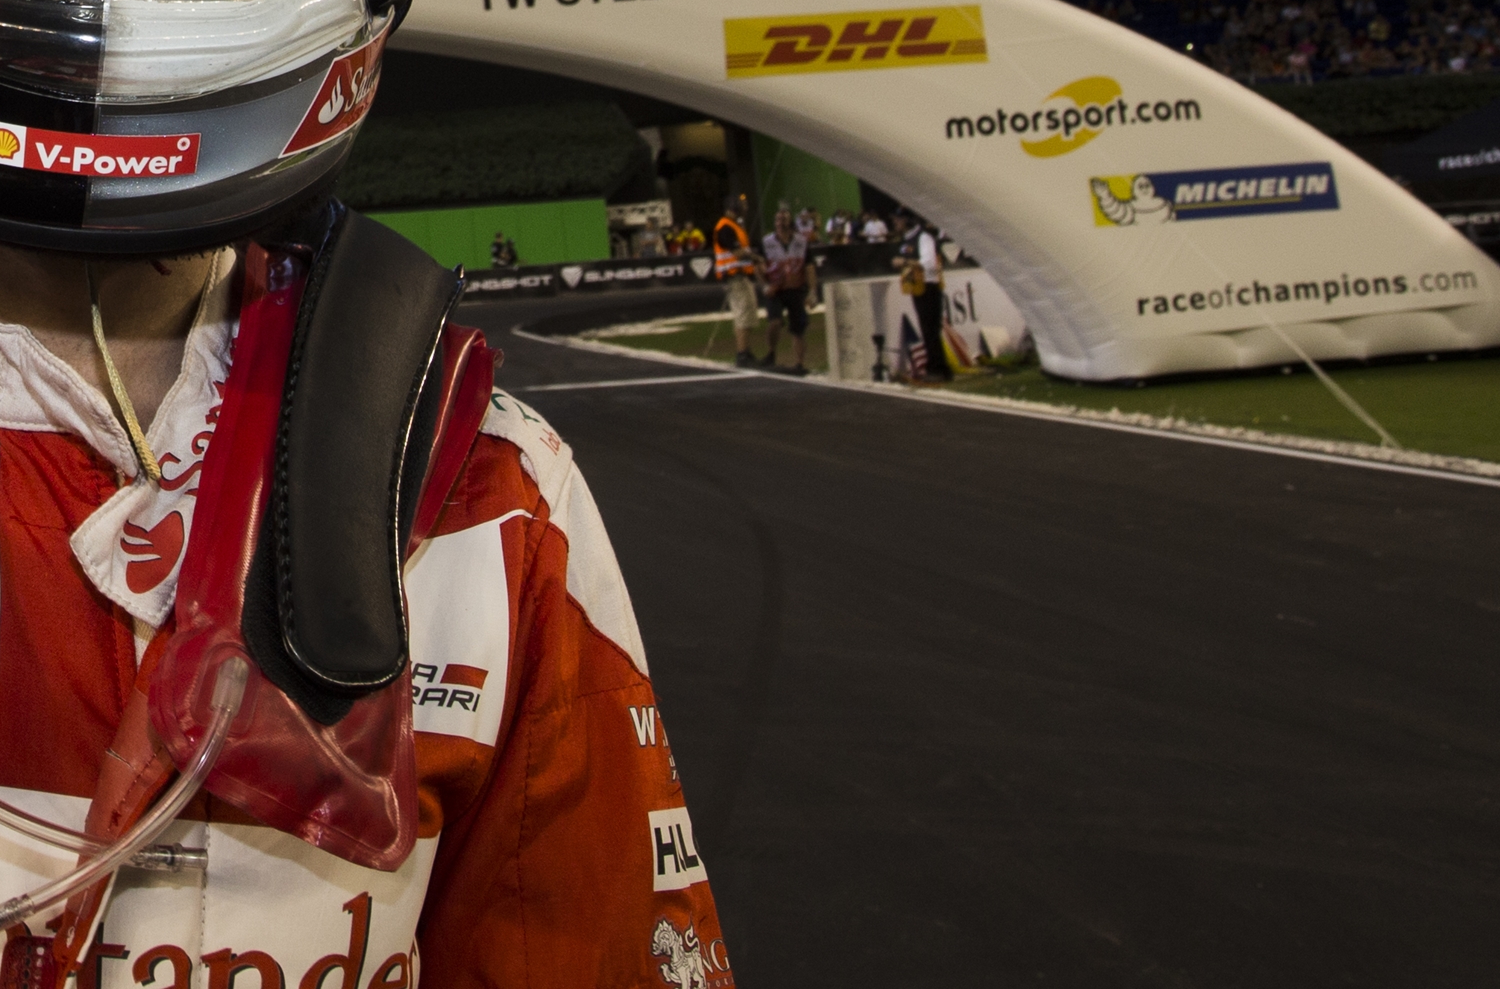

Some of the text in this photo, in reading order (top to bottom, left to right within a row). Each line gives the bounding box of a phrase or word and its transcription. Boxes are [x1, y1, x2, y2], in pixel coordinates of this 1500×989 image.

[760, 15, 952, 68] DHL
[945, 97, 1202, 139] motorsport.com
[34, 141, 184, 175] V-Power
[1174, 173, 1330, 204] MICHELIN
[1136, 268, 1479, 316] raceofchampions.com
